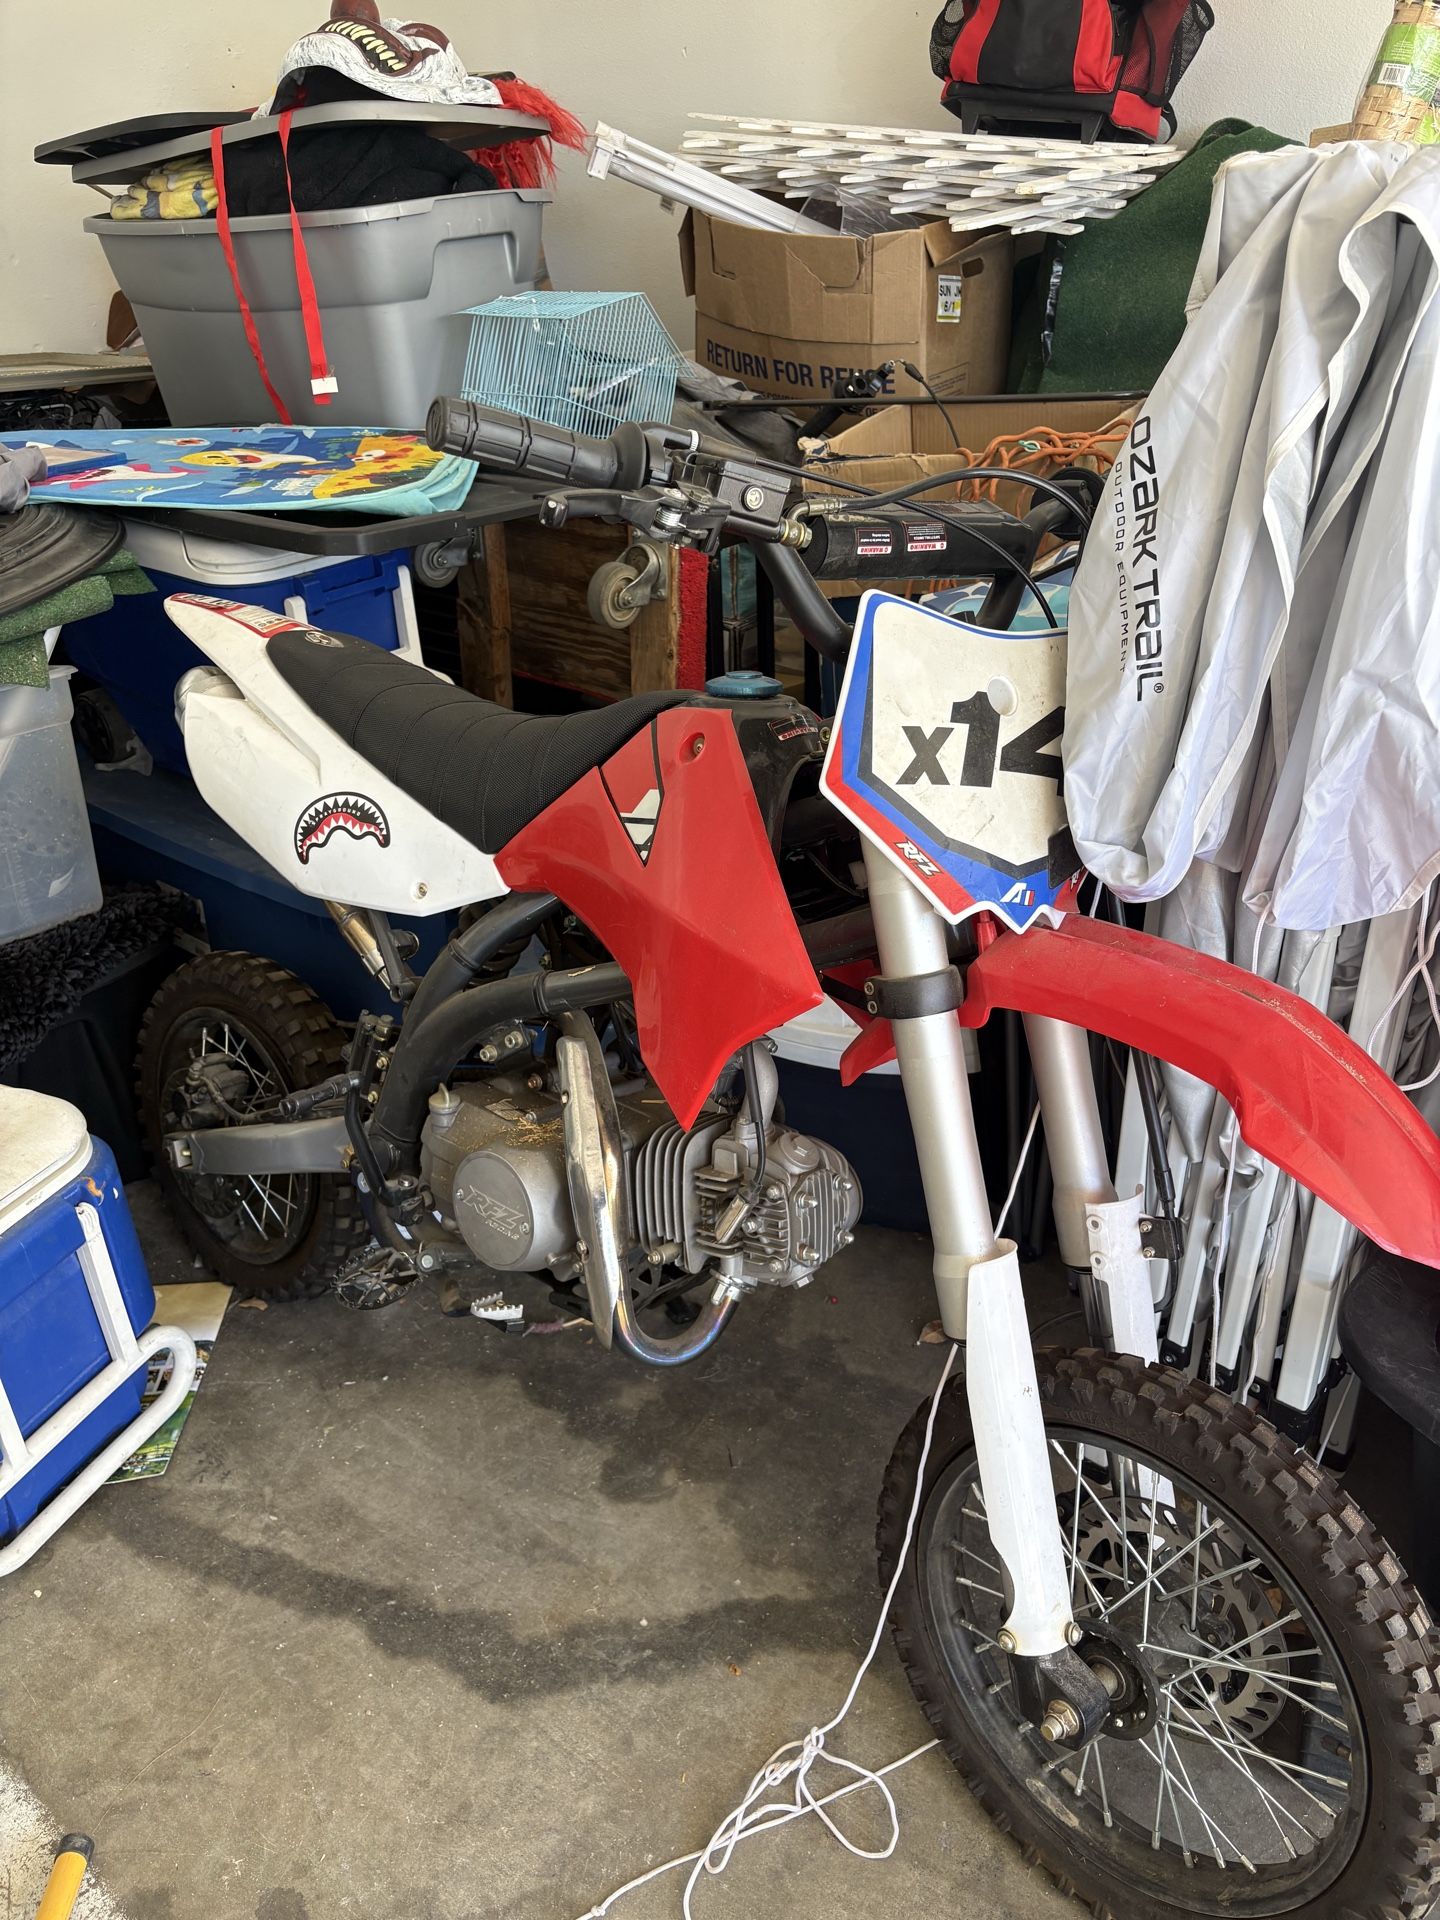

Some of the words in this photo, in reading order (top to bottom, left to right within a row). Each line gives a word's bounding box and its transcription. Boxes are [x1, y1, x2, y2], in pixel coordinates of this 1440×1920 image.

[706, 338, 769, 381] RETURN
[773, 358, 814, 387] FOR
[1114, 461, 1126, 552] OUTDOOR
[1116, 561, 1129, 673] EQUIPMENT
[895, 837, 943, 877] RFZ
[463, 1185, 525, 1230] RFZ
